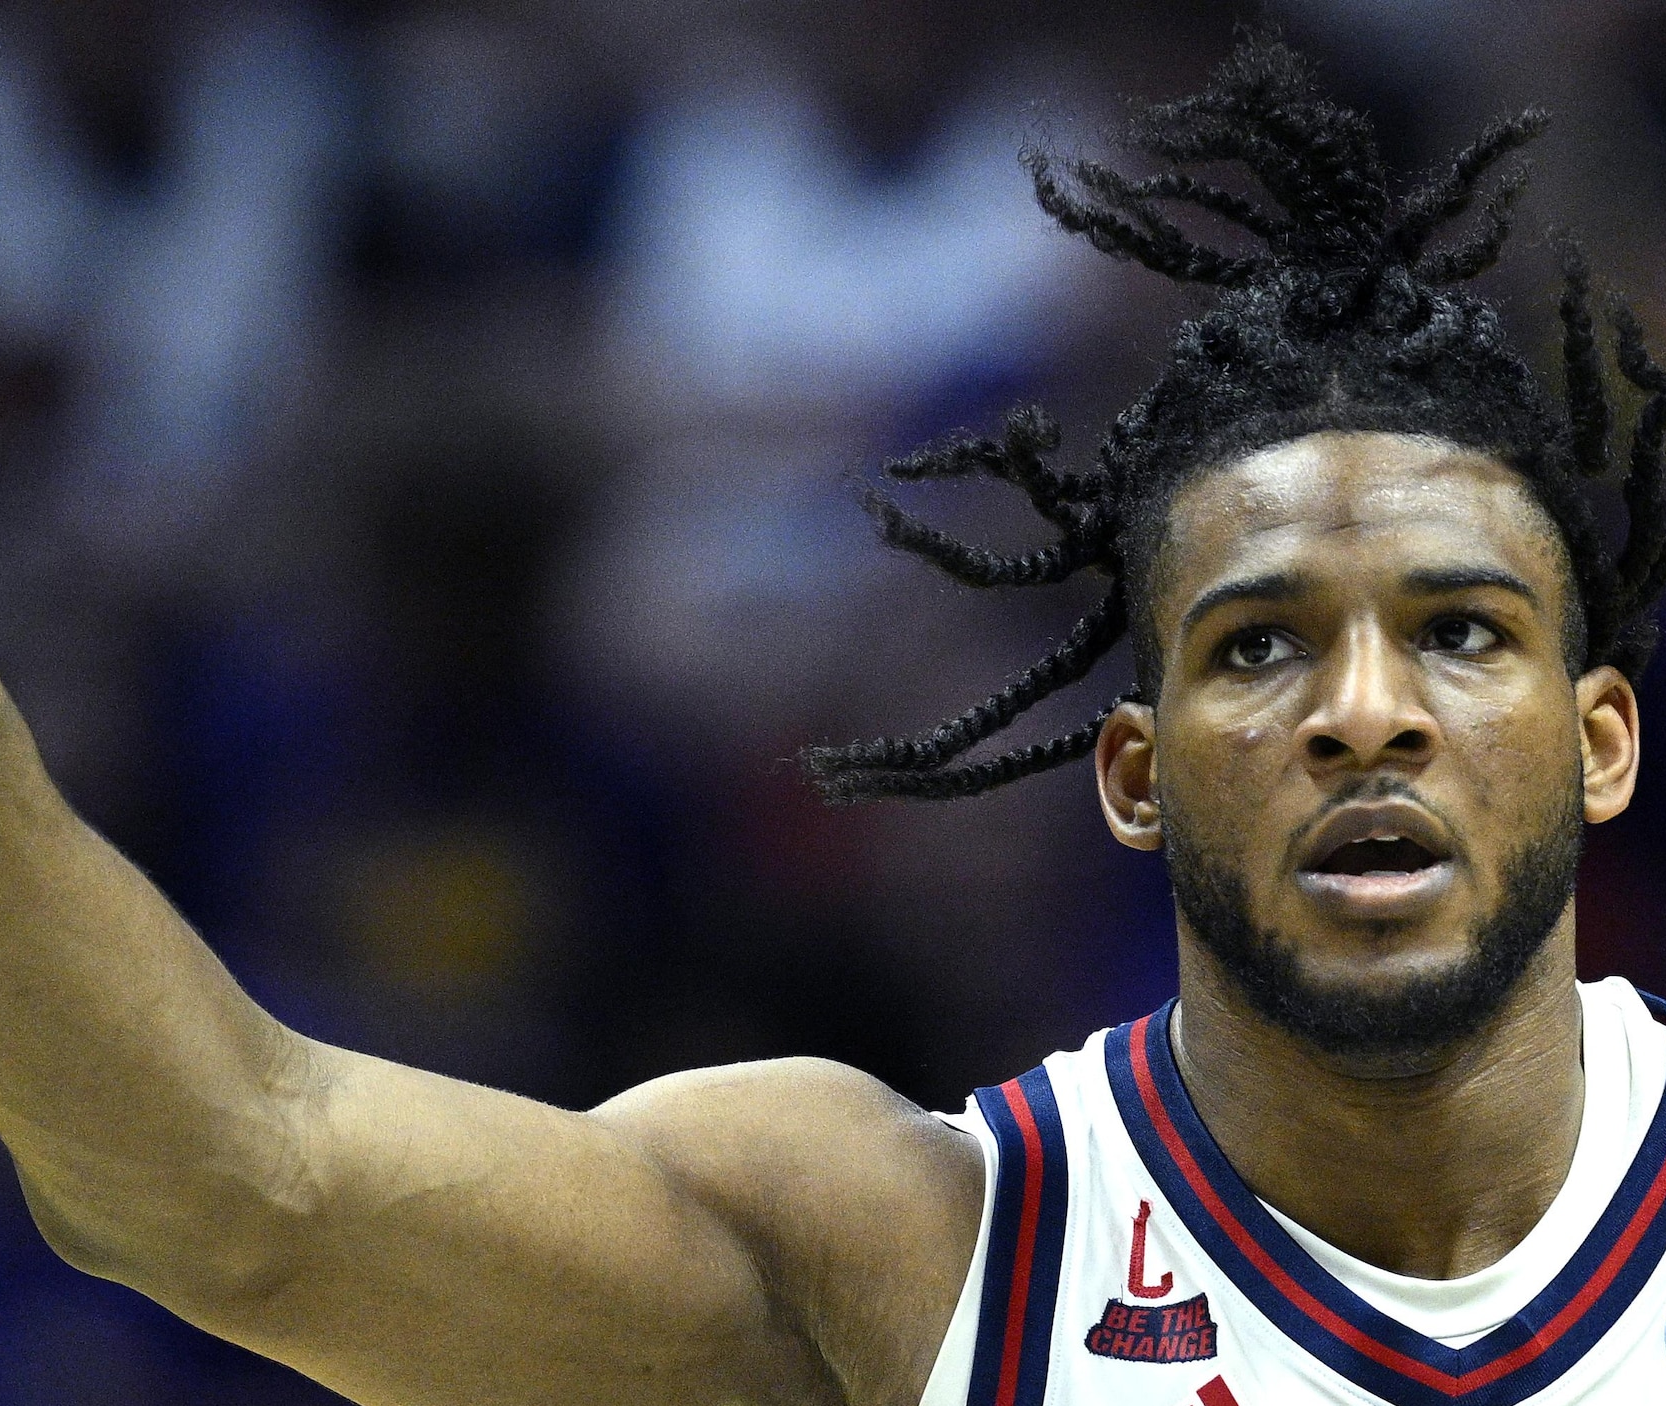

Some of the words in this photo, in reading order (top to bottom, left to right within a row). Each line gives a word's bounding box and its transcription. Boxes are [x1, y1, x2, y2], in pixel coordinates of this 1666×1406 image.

[1105, 1306, 1149, 1333] BE
[1161, 1299, 1209, 1333] THE
[1090, 1328, 1214, 1360] CHANGE
